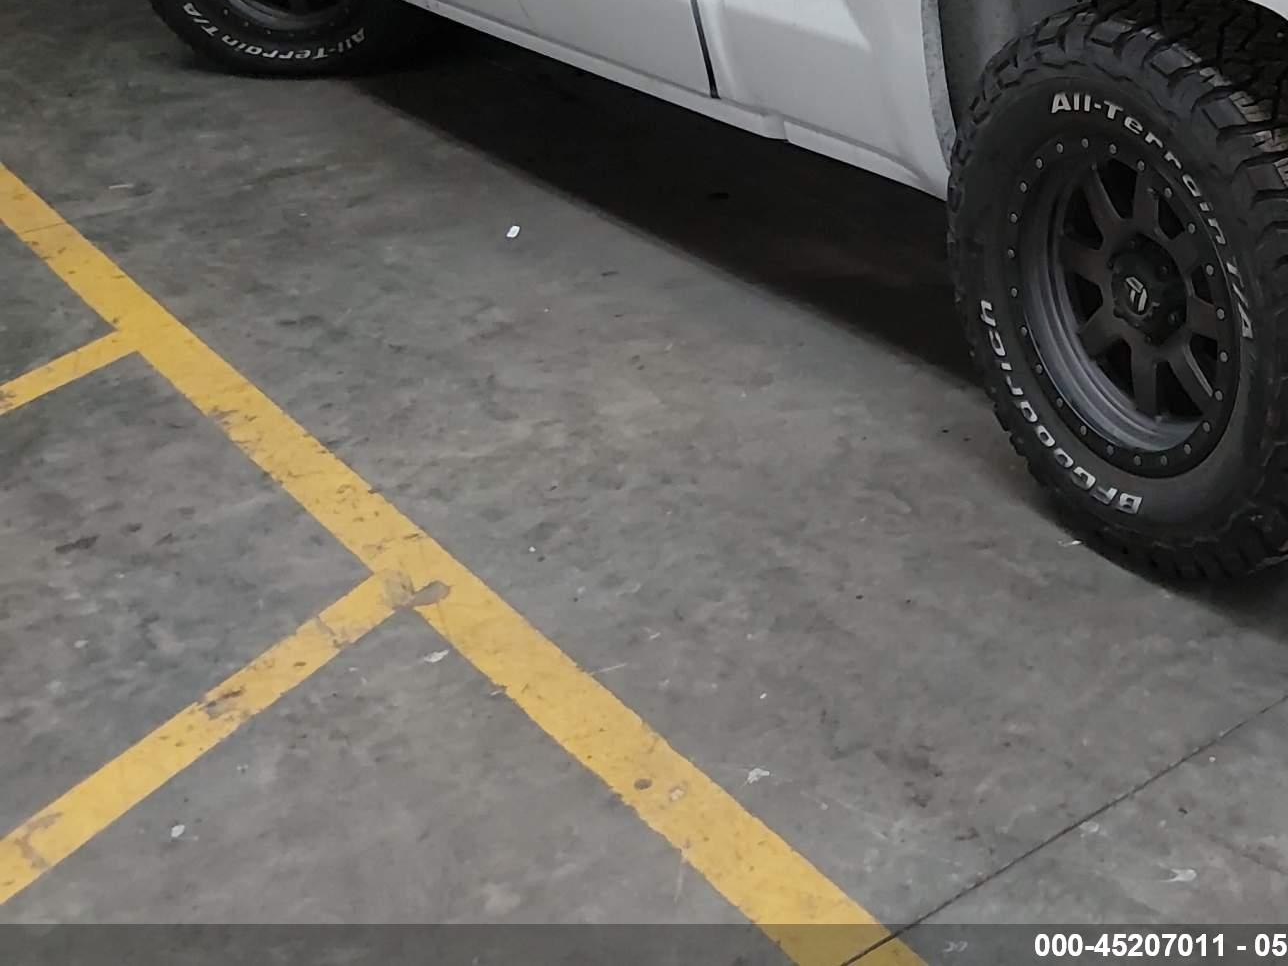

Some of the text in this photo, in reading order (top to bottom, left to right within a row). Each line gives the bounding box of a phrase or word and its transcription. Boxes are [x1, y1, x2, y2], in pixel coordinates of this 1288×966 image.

[183, 2, 366, 60] All-Terrain T/A
[1051, 92, 1254, 339] All-Terrain T/A
[980, 299, 1144, 515] BFGoodrich
